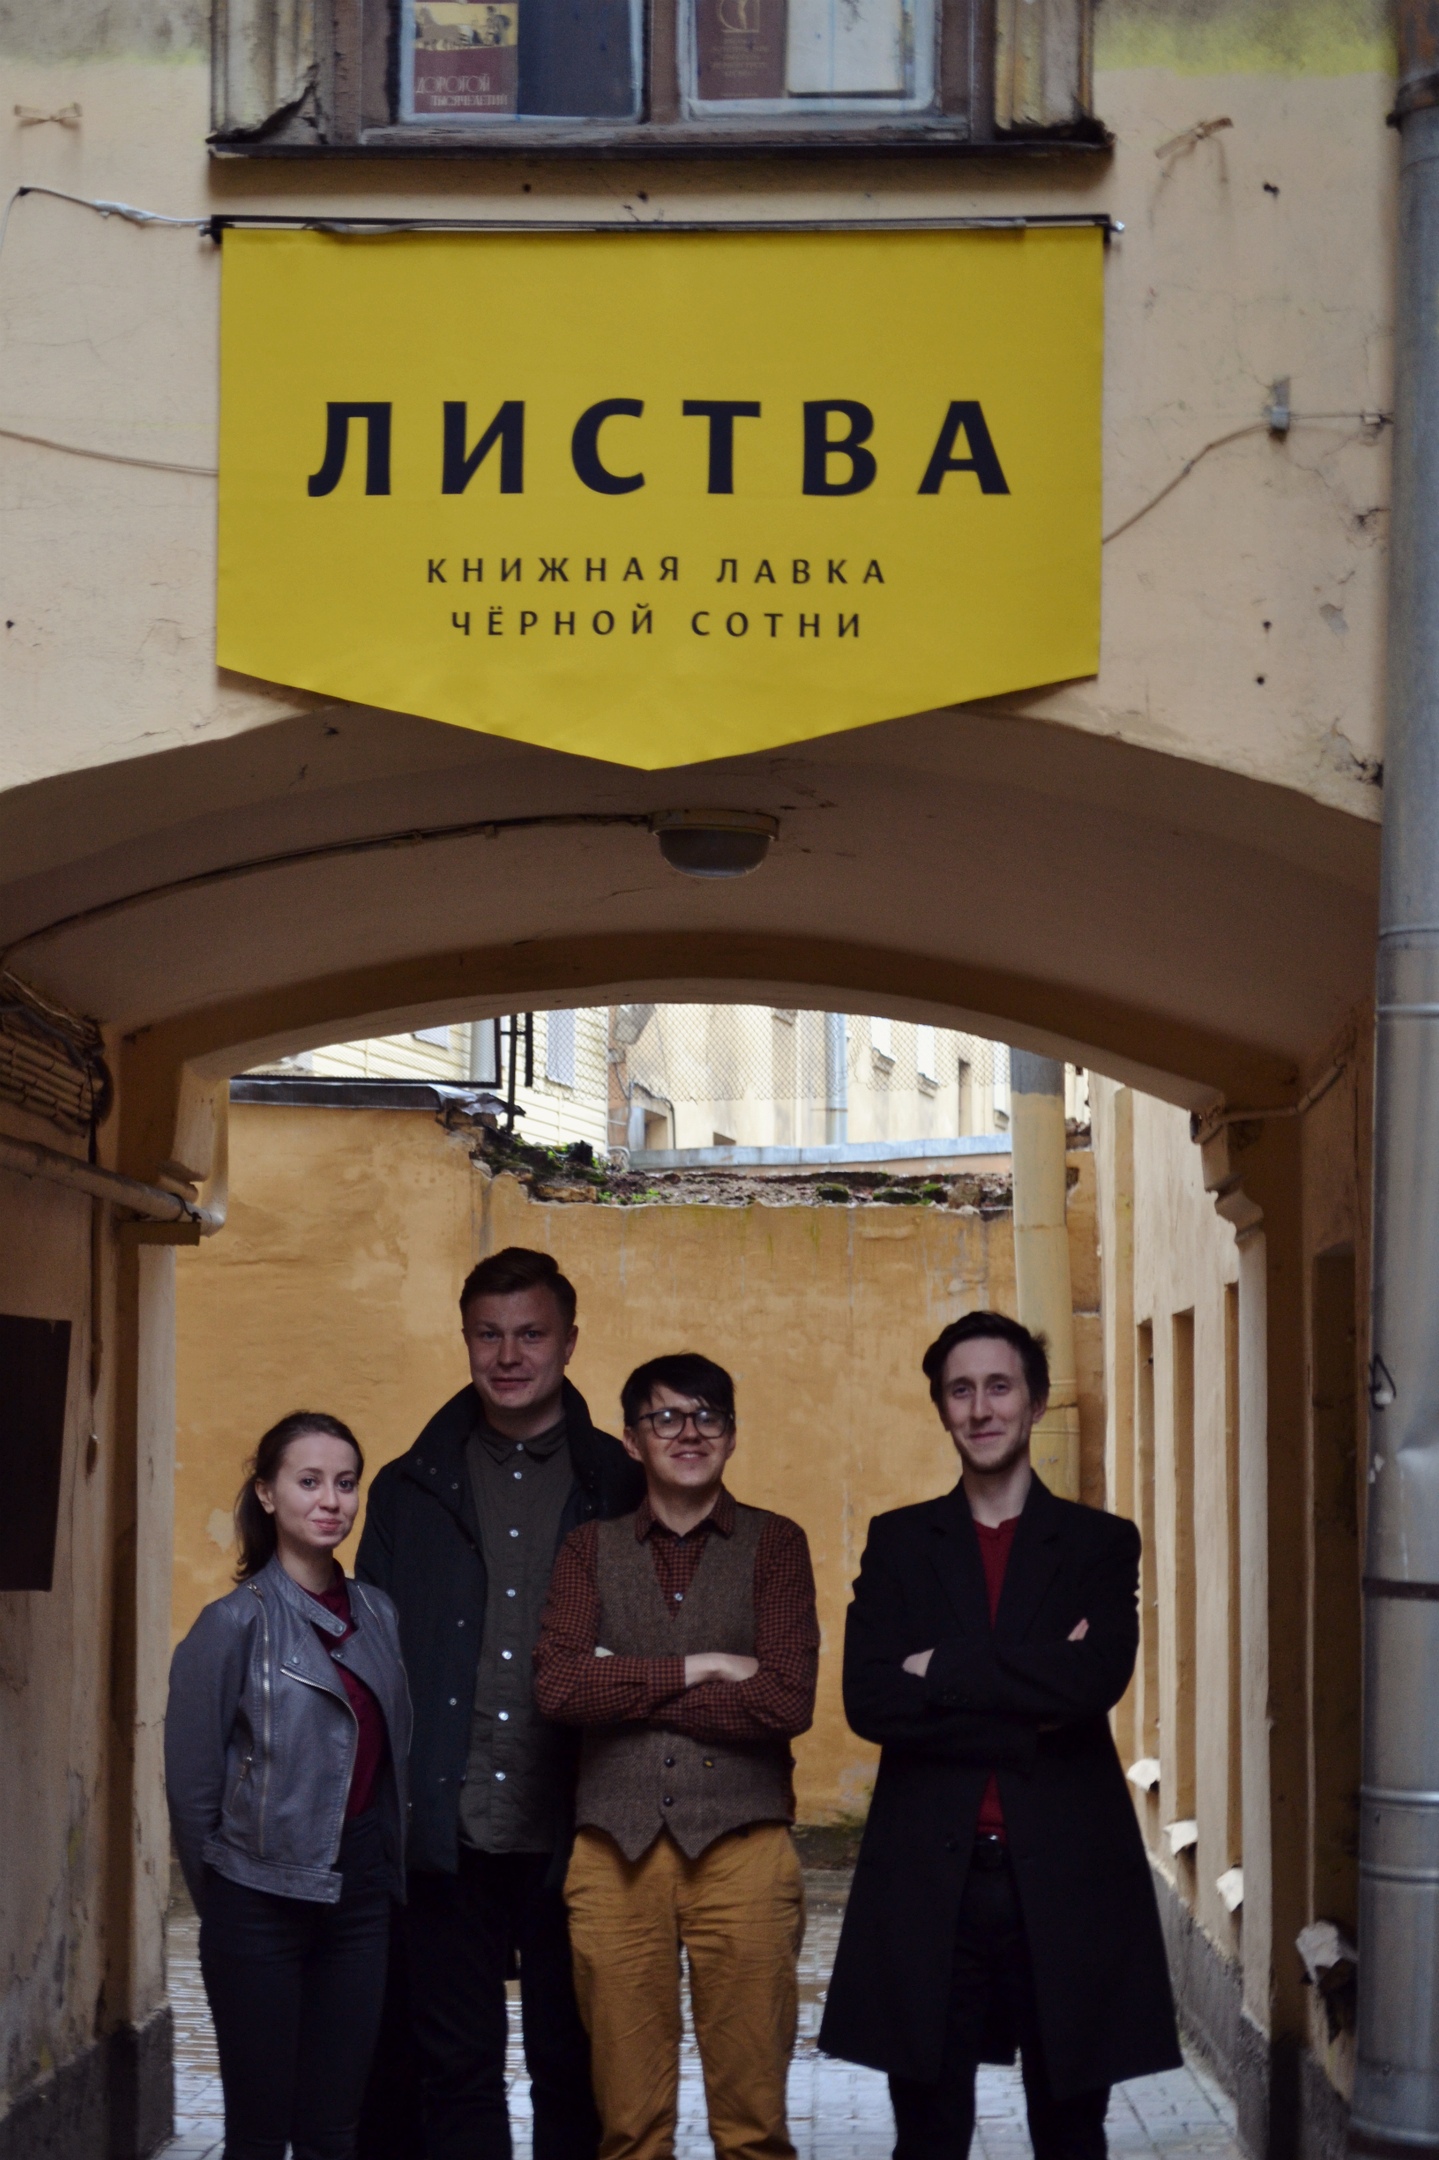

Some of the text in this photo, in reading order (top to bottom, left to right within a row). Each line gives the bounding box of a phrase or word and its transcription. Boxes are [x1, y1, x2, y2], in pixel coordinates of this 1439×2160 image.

[416, 73, 490, 94] ДОРОГОЙ
[307, 397, 1011, 498] ЛИСТВА
[427, 556, 886, 584] КНИЖНАЯ ЛАВКА
[451, 602, 860, 638] ЧЁРНОЙ СОТНИ
